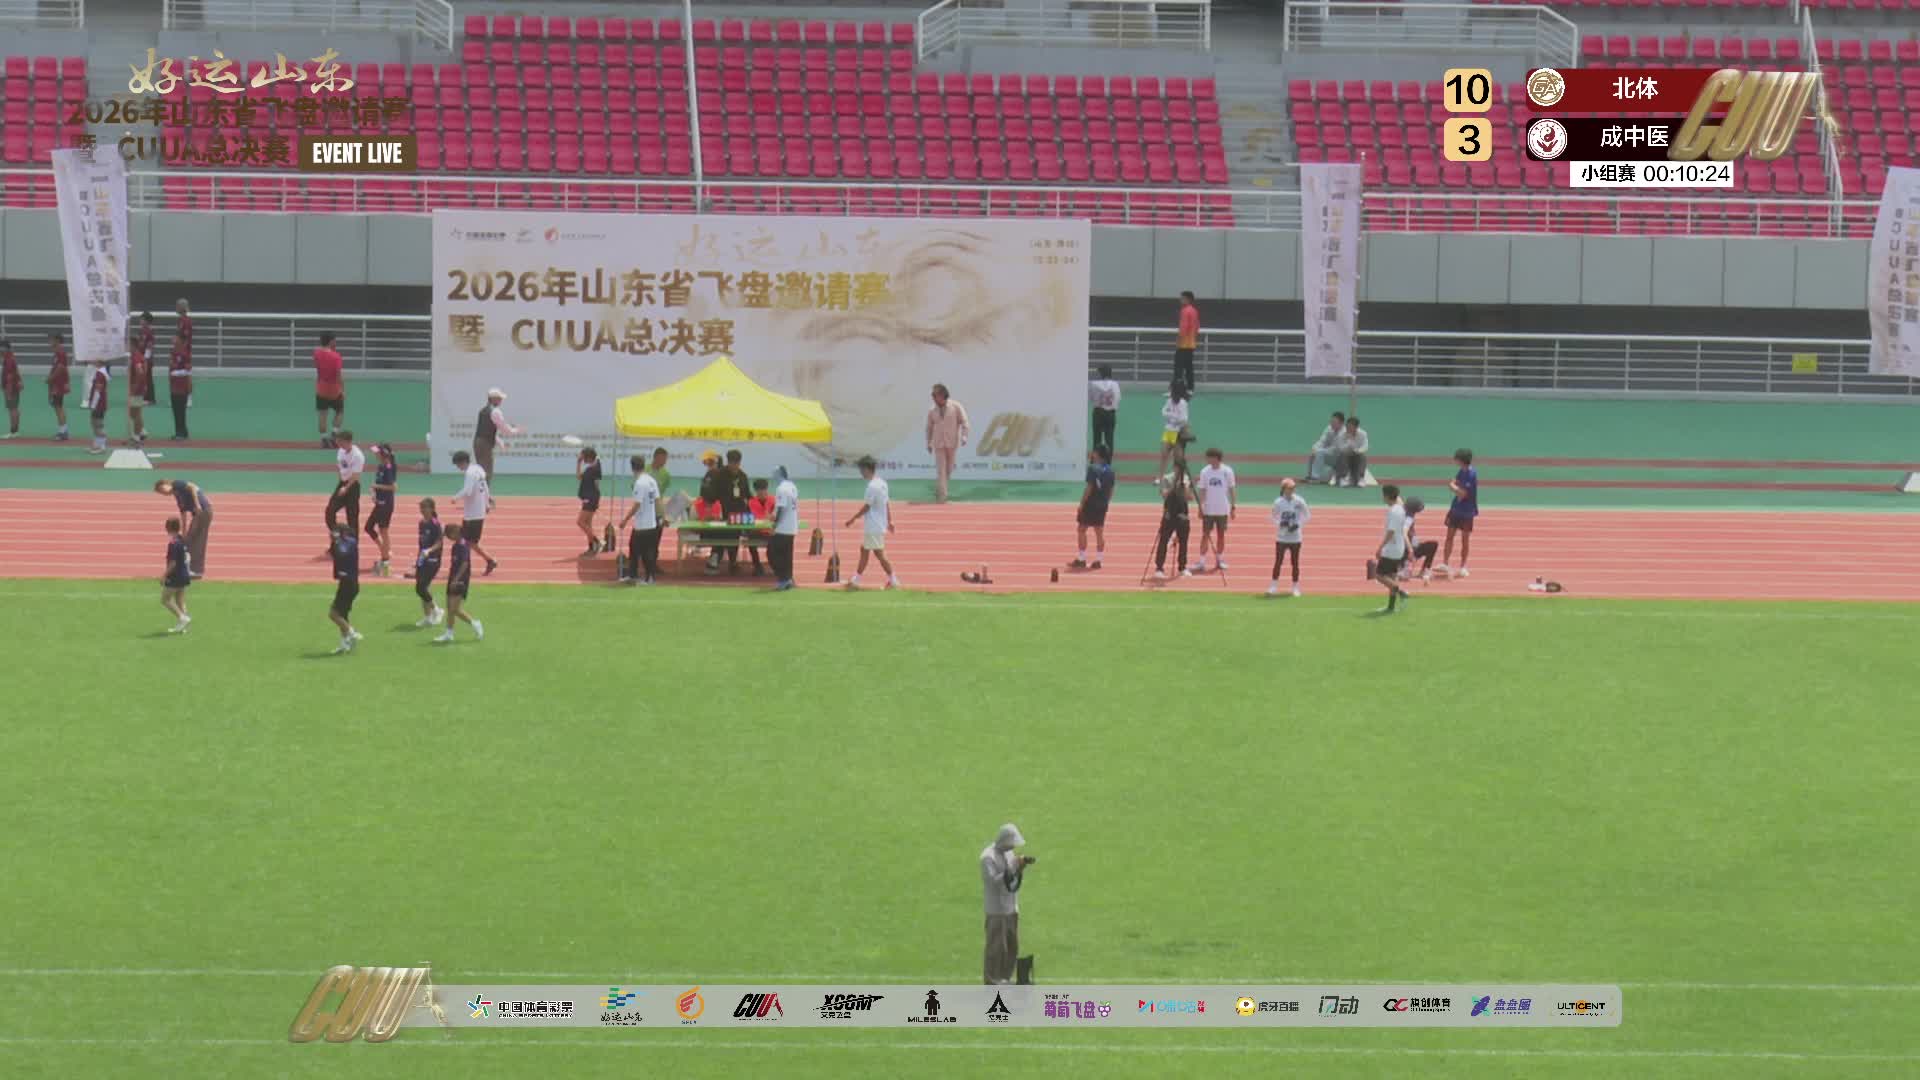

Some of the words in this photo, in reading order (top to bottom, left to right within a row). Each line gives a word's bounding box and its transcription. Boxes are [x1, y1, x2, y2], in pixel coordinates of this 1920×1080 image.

[447, 267, 891, 310] 2026年山东省飞盘邀请赛
[511, 317, 736, 356] CUUA总决赛
